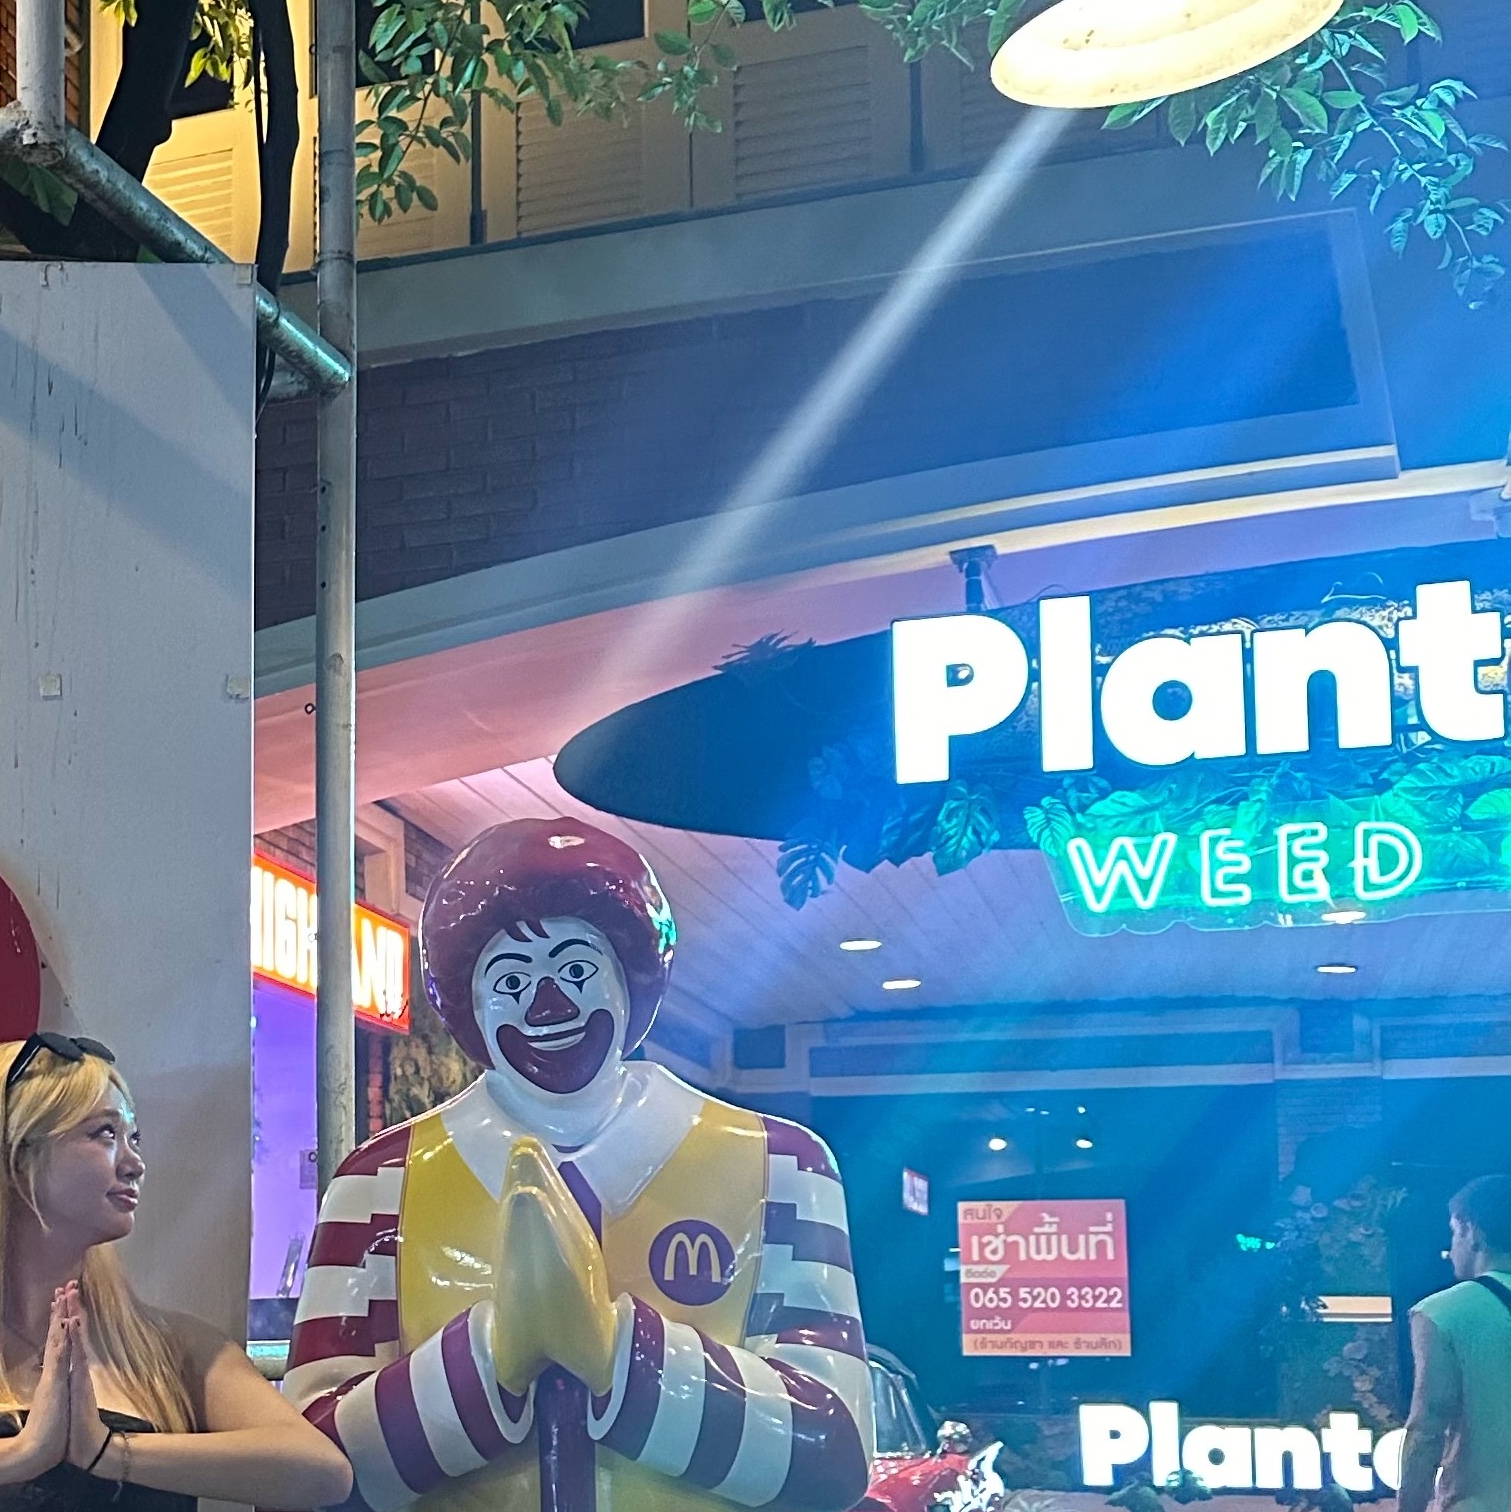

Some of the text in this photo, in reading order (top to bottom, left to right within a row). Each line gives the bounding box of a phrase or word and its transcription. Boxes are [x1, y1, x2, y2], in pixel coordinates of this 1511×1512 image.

[1067, 820, 1423, 914] WEED
[970, 1286, 1124, 1309] 065 520 3322
